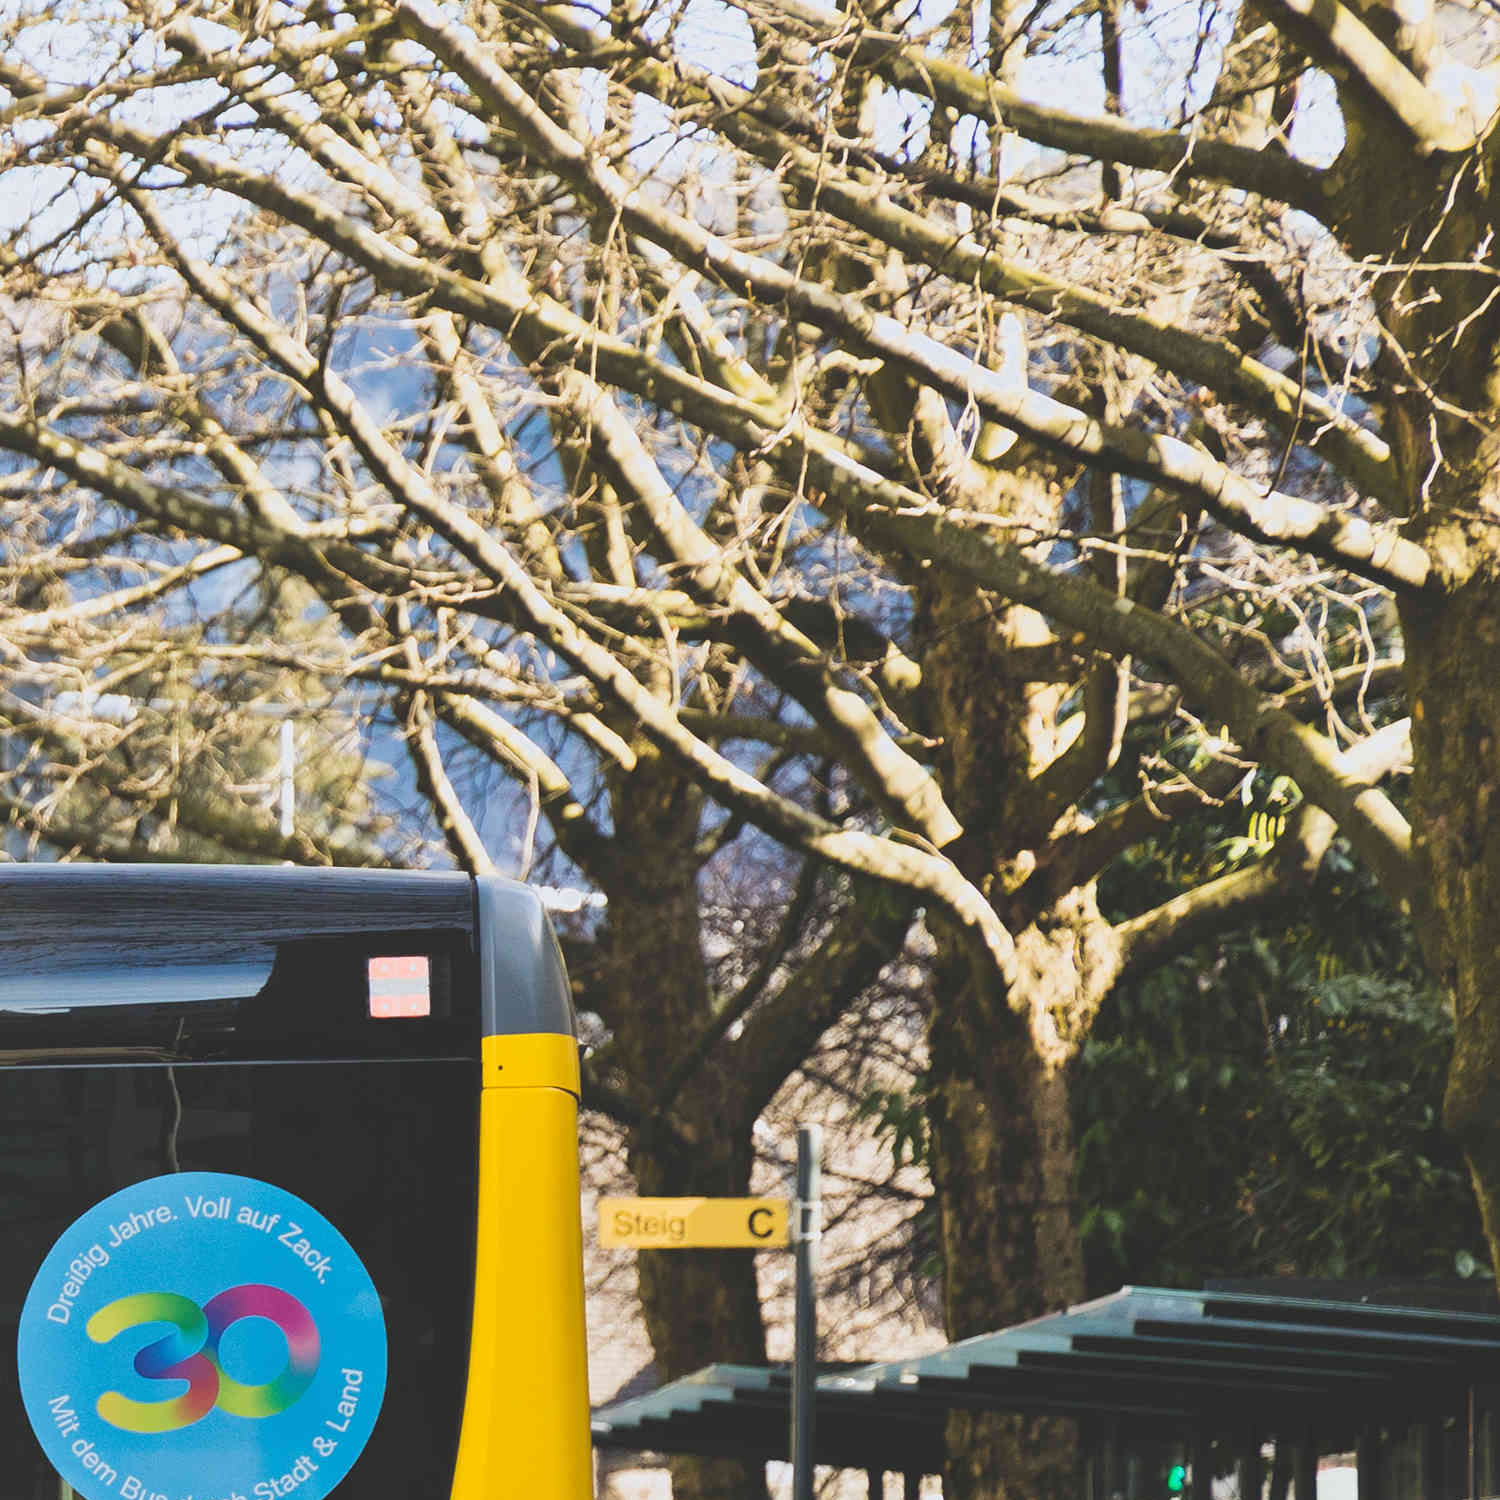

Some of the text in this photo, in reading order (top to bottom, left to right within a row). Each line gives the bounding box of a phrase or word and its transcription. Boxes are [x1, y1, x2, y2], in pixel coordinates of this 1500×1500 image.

[47, 1196, 333, 1325] Dreißig Jahre. Voll auf Zack.
[614, 1207, 774, 1241] Steig C
[47, 1394, 80, 1438] Mit
[71, 1436, 119, 1487] dem
[311, 1434, 339, 1458] &
[325, 1367, 364, 1433] Land
